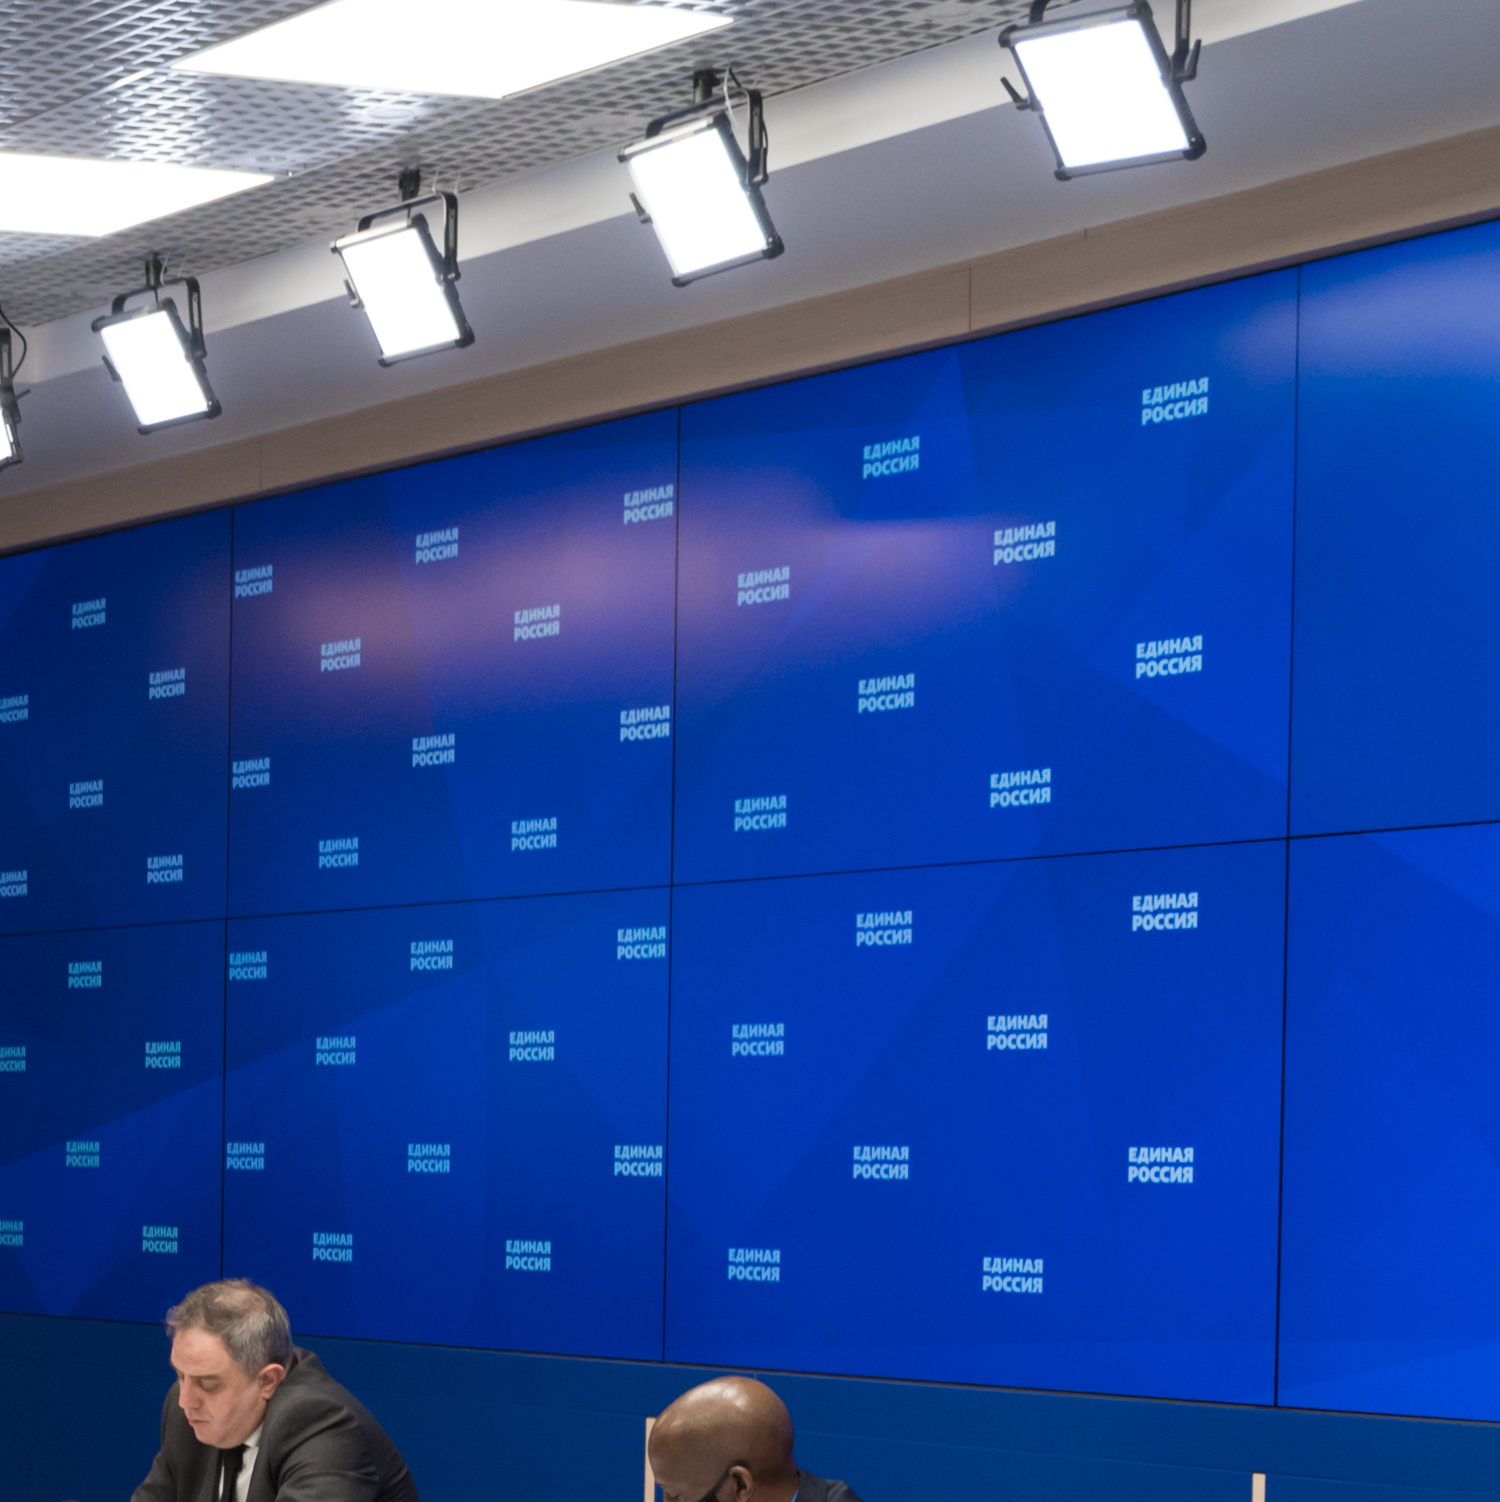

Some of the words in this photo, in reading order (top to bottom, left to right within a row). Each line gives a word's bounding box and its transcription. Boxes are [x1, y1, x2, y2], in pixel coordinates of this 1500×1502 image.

[1142, 377, 1209, 405] ЕДИНАЯ
[1141, 396, 1209, 425] РОССИЯ
[863, 436, 920, 460] ЕДИНАЯ
[863, 454, 920, 478] РОССИЯ
[623, 484, 674, 508] ЕДИНАЯ
[622, 501, 675, 527] РОССИЯ
[415, 528, 459, 548] ЕДИНАЯ
[993, 521, 1056, 546] ЕДИНАЯ
[415, 542, 459, 563] РОССИЯ
[992, 540, 1056, 566] РОССИЯ
[737, 566, 791, 588] ЕДИНАЯ
[737, 584, 790, 606] РОССИЯ
[513, 603, 561, 625] ЕДИНАЯ
[513, 620, 561, 641] РОССИЯ
[1135, 635, 1203, 659] ЕДИНАЯ
[1135, 654, 1203, 678] РОССИЯ
[149, 668, 186, 686] ЕДИНАЯ
[858, 674, 915, 695] ЕДИНАЯ
[148, 682, 186, 699] РОССИЯ
[857, 692, 915, 713] РОССИЯ
[619, 705, 671, 725] ЕДИНАЯ
[619, 722, 671, 742] РОССИЯ
[412, 734, 456, 752] ЕДИНАЯ
[411, 749, 456, 767] РОССИЯ
[990, 768, 1052, 789] ЕДИНАЯ
[734, 795, 787, 814] ЕДИНАЯ
[989, 787, 1051, 807] РОССИЯ
[511, 818, 557, 834] ЕДИНАЯ
[734, 813, 787, 831] РОССИЯ
[511, 834, 557, 850] РОССИЯ
[1132, 892, 1199, 912] ЕДИНАЯ
[856, 911, 913, 928] ЕДИНАЯ
[1131, 912, 1199, 931] РОССИЯ
[617, 927, 667, 943] ЕДИНАЯ
[856, 929, 913, 946] РОССИЯ
[410, 940, 454, 955] ЕДИНАЯ
[617, 944, 666, 959] РОССИЯ
[410, 956, 453, 970] РОССИЯ
[732, 1024, 785, 1039] ЕДИНАЯ
[987, 1014, 1049, 1032] ЕДИНАЯ
[316, 1037, 357, 1050] ЕДИНАЯ
[509, 1031, 555, 1045] ЕДИНАЯ
[987, 1033, 1048, 1050] РОССИЯ
[145, 1042, 181, 1054] ЕДИНАЯ
[509, 1047, 555, 1060] РОССИЯ
[731, 1041, 785, 1056] РОССИЯ
[145, 1056, 181, 1068] РОССИЯ
[315, 1052, 356, 1064] РОССИЯ
[614, 1146, 663, 1160] ЕДИНАЯ
[853, 1146, 910, 1162] ЕДИНАЯ
[1128, 1147, 1194, 1164] ЕДИНАЯ
[613, 1162, 663, 1176] РОССИЯ
[852, 1164, 909, 1179] РОССИЯ
[1127, 1166, 1194, 1183] РОССИЯ
[505, 1240, 551, 1254] ЕДИНАЯ
[505, 1256, 551, 1271] РОССИЯ
[728, 1249, 781, 1263] ЕДИНАЯ
[727, 1266, 781, 1281] РОССИЯ
[982, 1257, 1044, 1274] ЕДИНАЯ
[982, 1276, 1043, 1293] РОССИЯ
